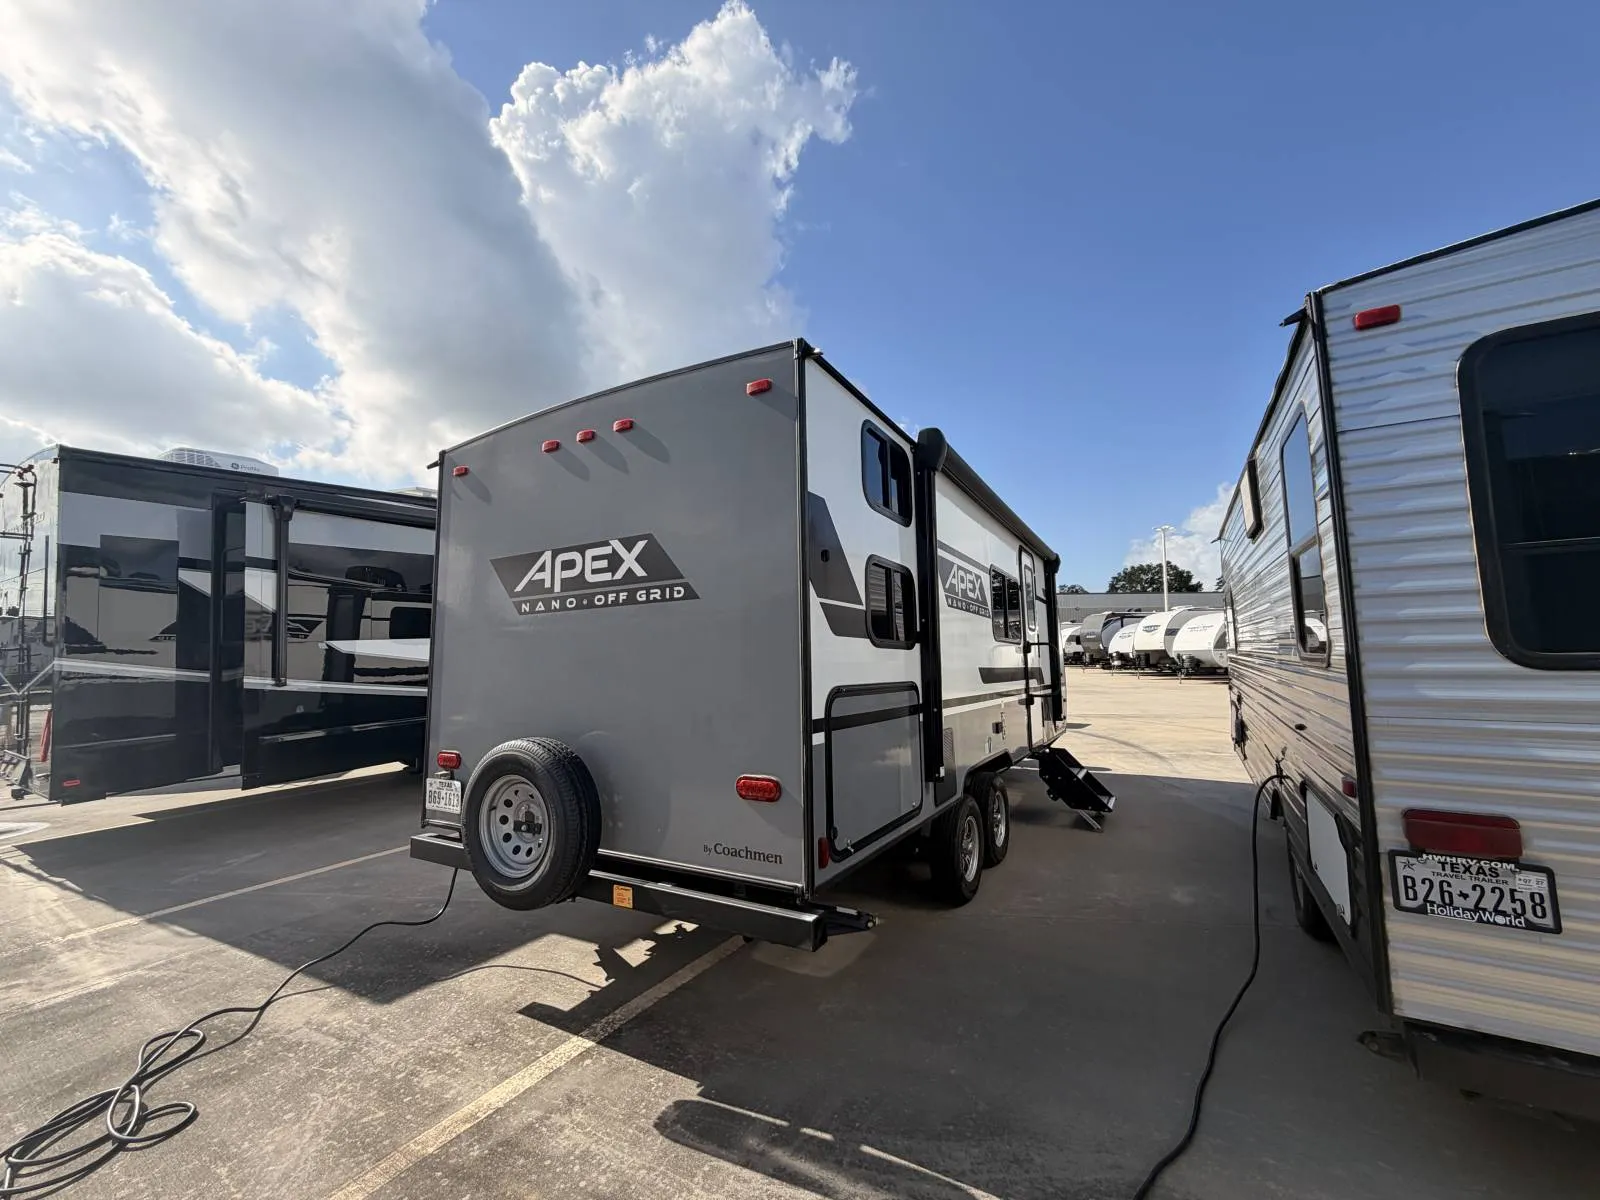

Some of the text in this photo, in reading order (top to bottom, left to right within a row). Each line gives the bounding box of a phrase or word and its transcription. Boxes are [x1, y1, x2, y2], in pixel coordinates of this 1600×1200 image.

[513, 539, 648, 593] APEX
[945, 564, 982, 601] APEX
[521, 586, 685, 613] NANO OFF GRID
[703, 843, 783, 864] By Coachmen
[1421, 853, 1515, 871] HWHRV.COM
[1431, 870, 1509, 886] TRAVEL TRAILER
[1437, 862, 1500, 878] TEXAS
[1402, 875, 1547, 919] B26 2258
[1426, 902, 1526, 927] HolidayWorld
